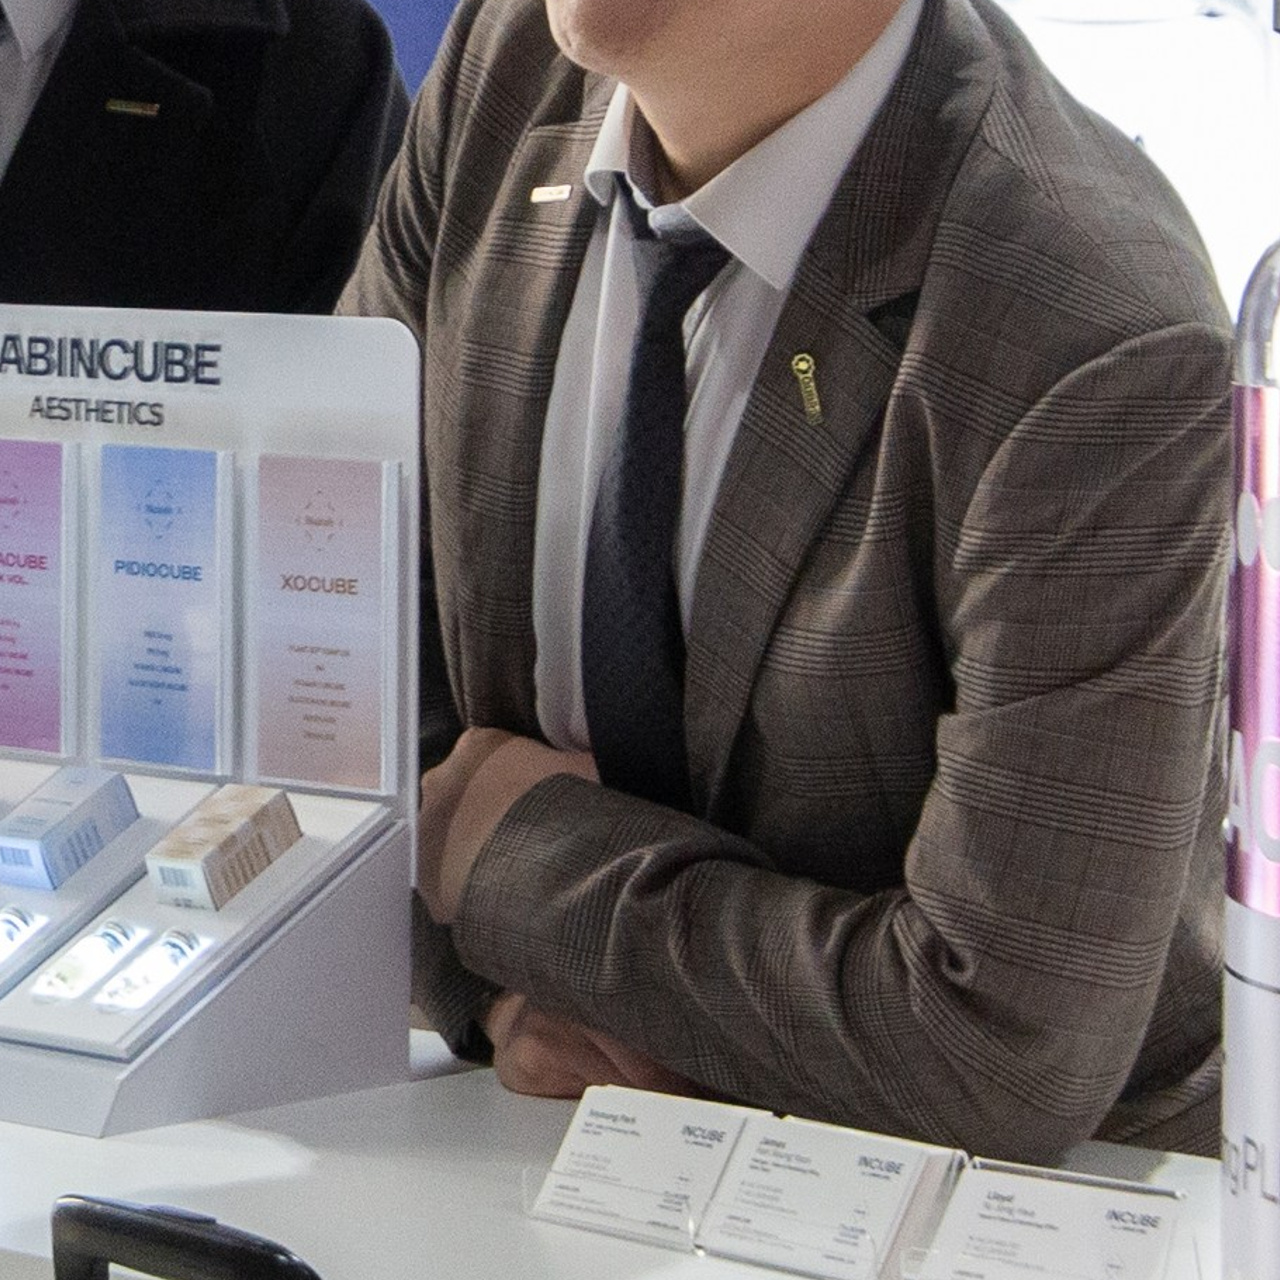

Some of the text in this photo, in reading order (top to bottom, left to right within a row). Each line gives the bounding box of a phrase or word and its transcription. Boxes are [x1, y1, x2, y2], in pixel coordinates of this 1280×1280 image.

[28, 394, 166, 427] AESTHETICS
[280, 574, 359, 596] XOCUBE
[682, 1123, 726, 1144] INCUBE
[1106, 1208, 1162, 1229] INCUBE
